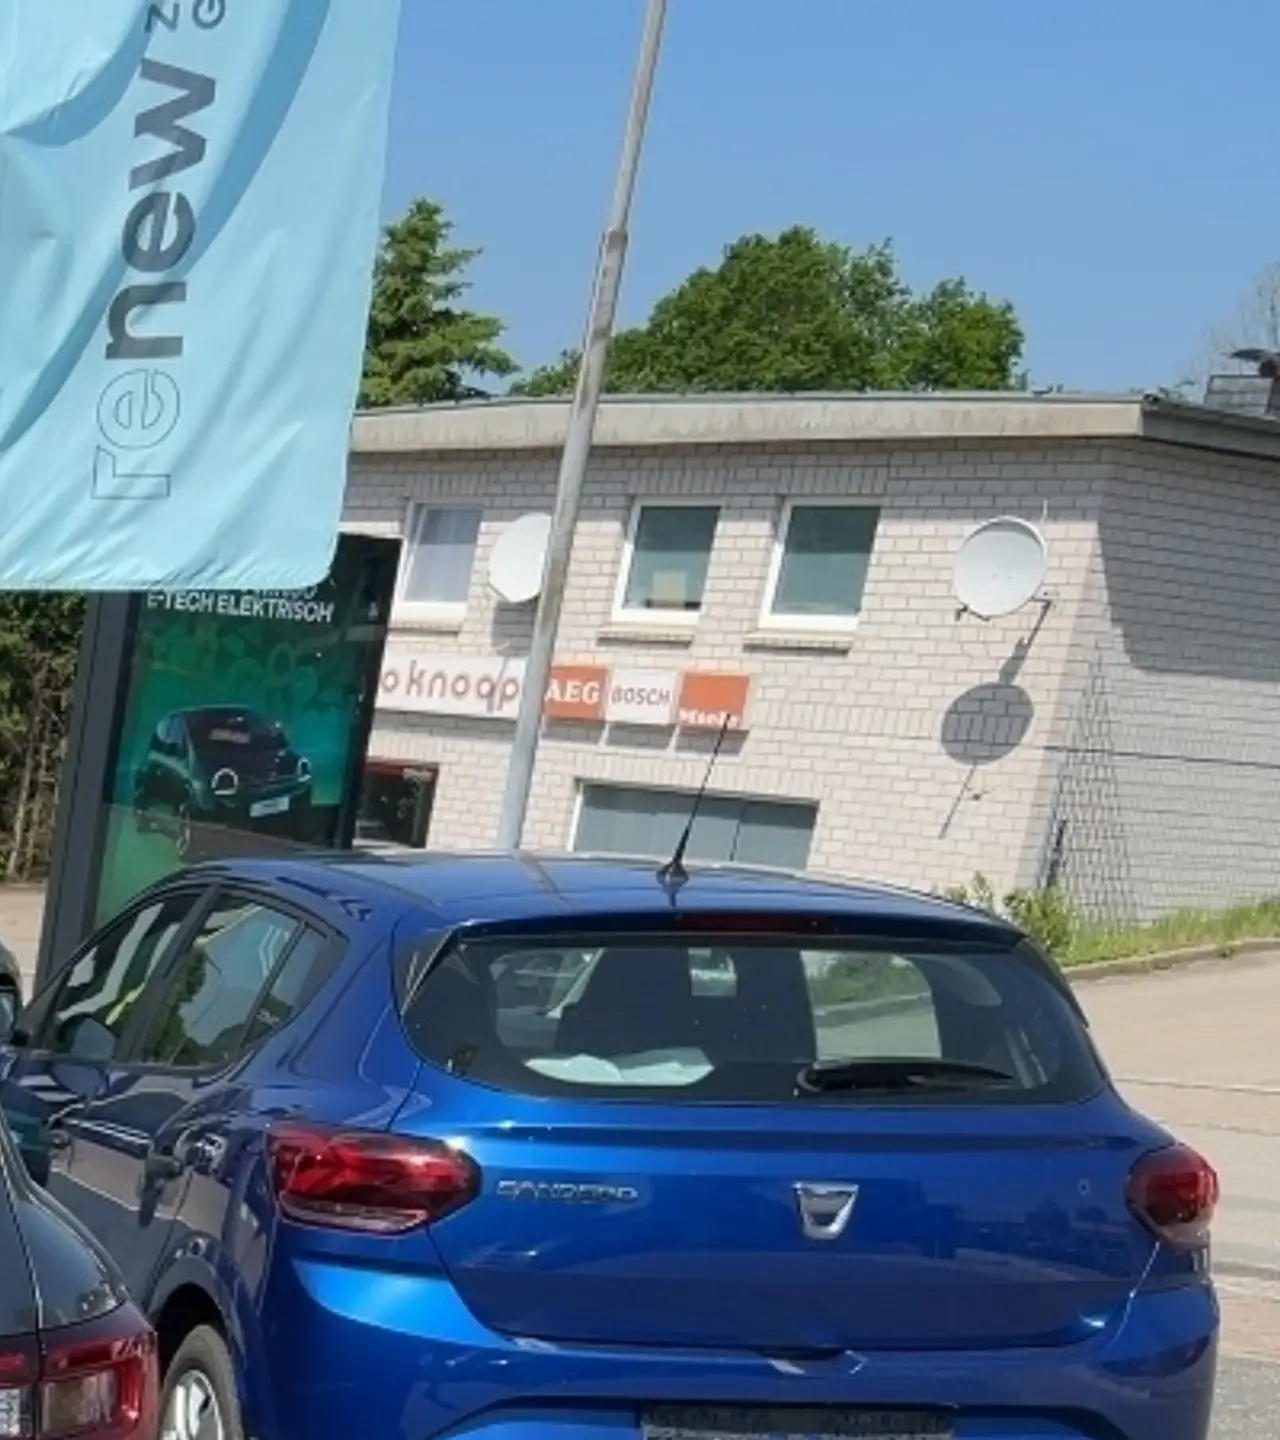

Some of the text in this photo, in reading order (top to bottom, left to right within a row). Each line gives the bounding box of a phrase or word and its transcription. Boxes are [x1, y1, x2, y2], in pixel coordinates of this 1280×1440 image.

[92, 57, 216, 500] renew
[146, 587, 215, 613] E-TECH
[216, 594, 335, 623] ELEKTRISCH
[544, 679, 600, 706] AEG
[611, 685, 671, 706] BOSCH
[496, 1179, 639, 1202] SANDERO
